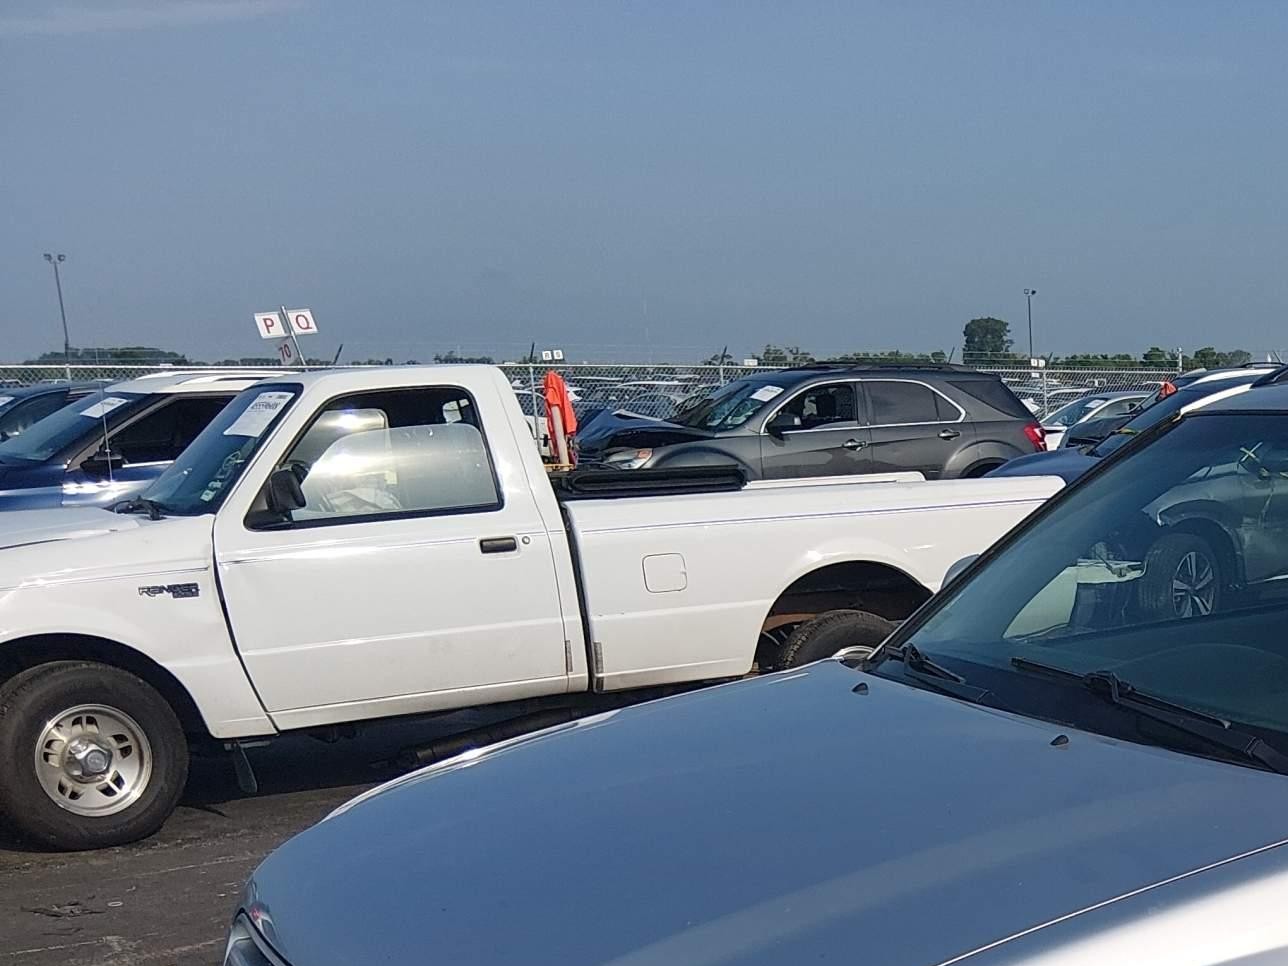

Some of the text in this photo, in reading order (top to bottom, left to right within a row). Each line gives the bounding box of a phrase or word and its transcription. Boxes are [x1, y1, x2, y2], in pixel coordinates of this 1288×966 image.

[262, 314, 312, 334] P Q
[278, 343, 292, 362] 70
